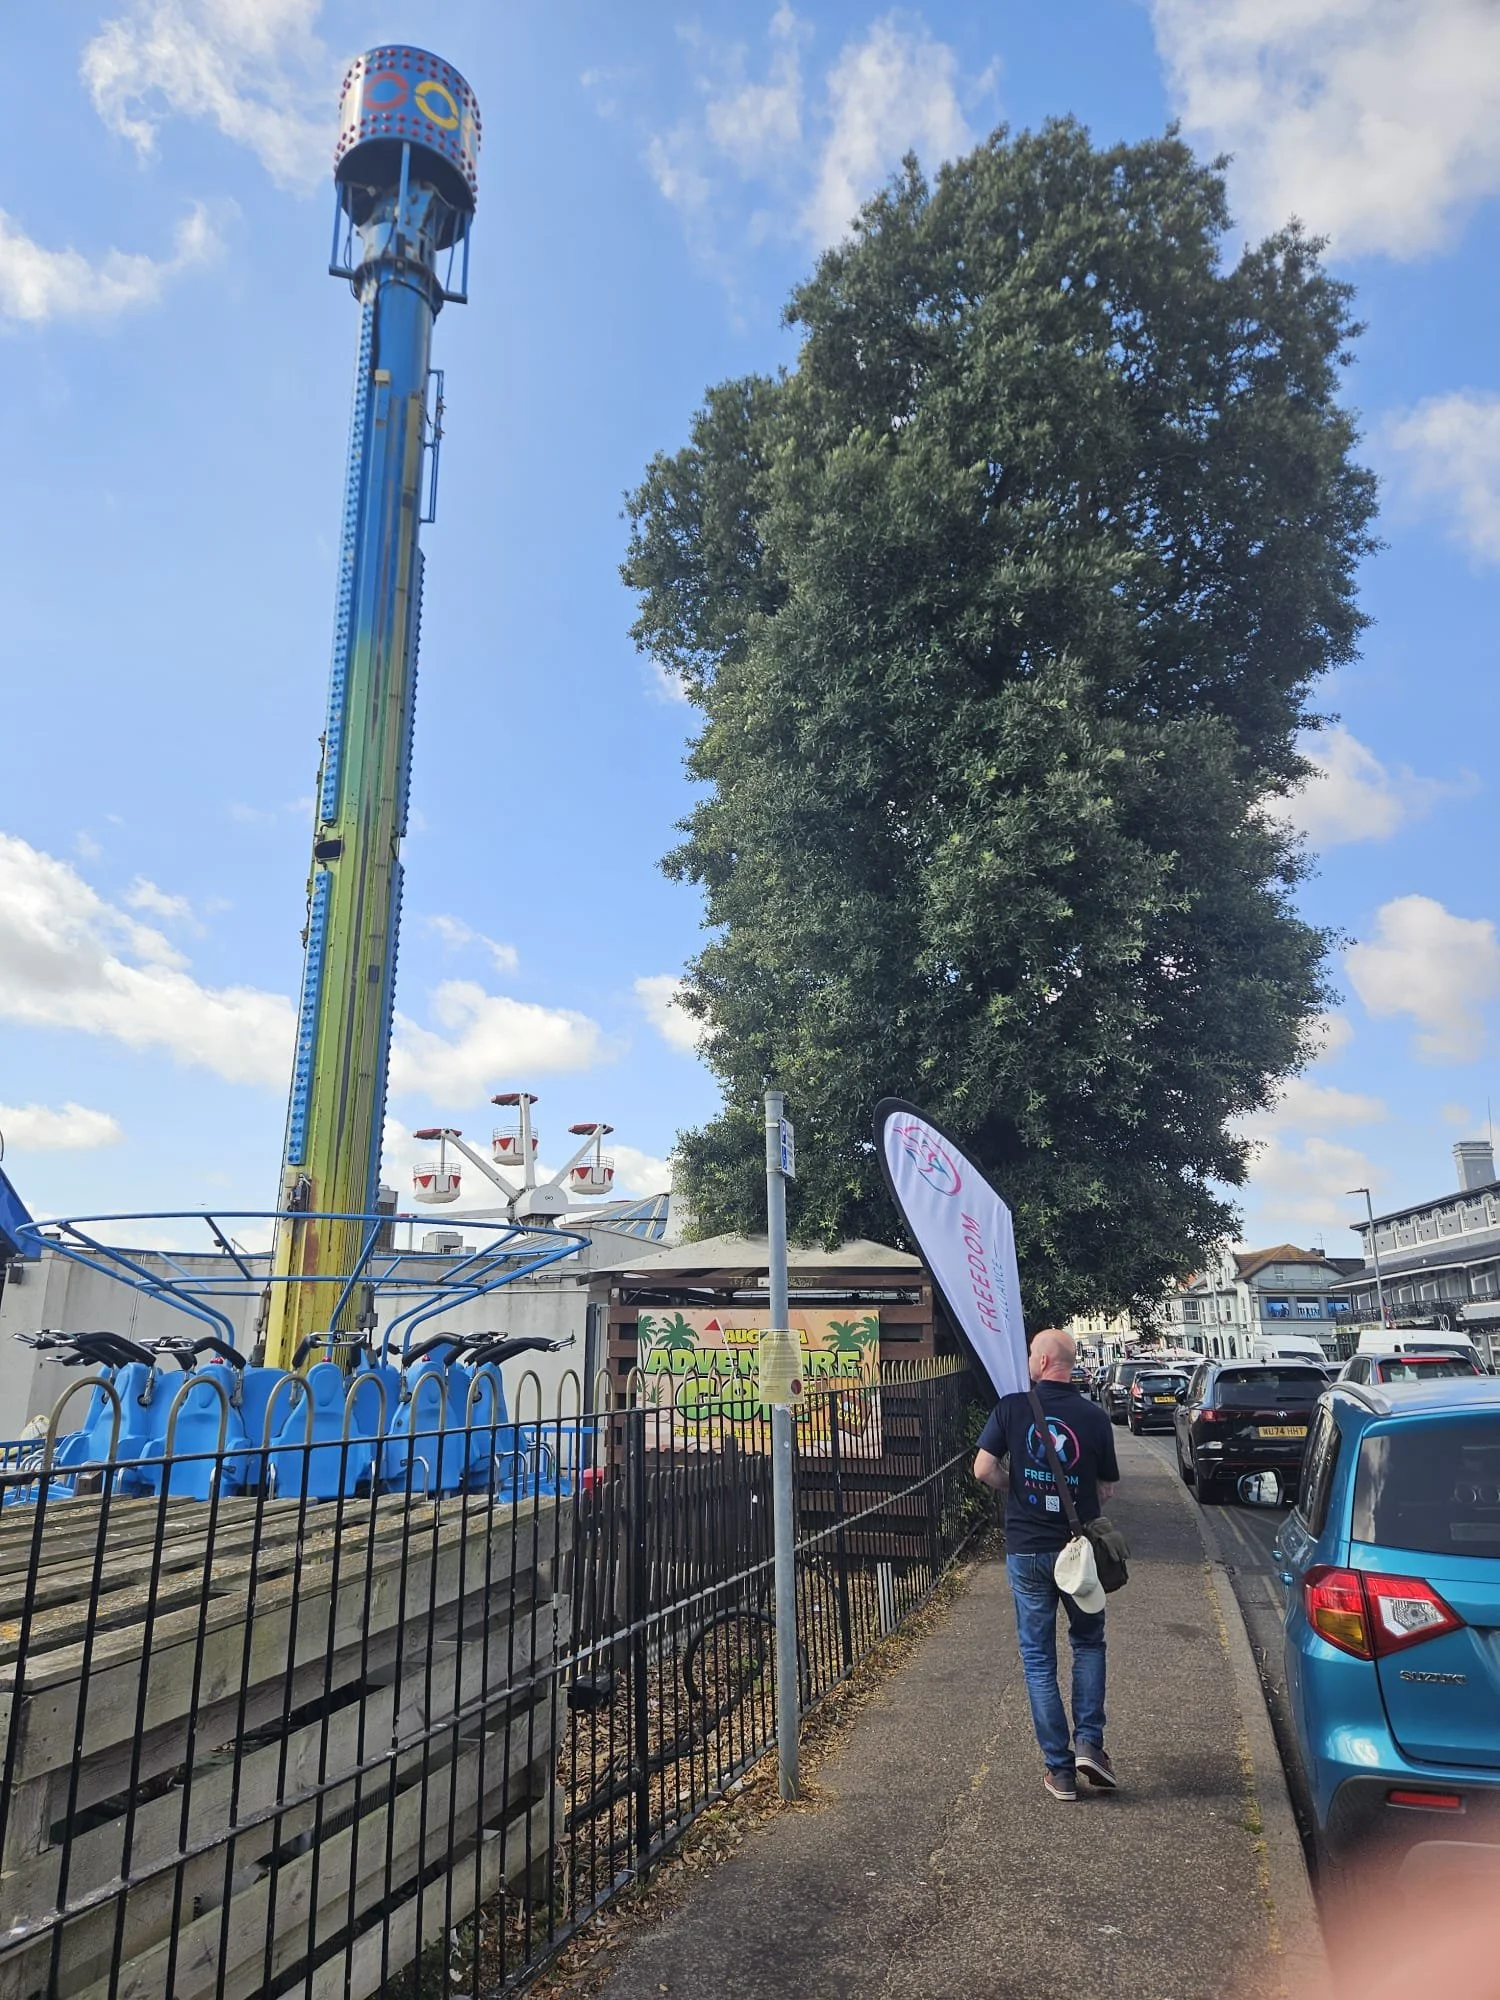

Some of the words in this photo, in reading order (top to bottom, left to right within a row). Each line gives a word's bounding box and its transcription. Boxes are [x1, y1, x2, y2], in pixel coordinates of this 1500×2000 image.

[960, 1212, 1002, 1333] FREEDOM
[991, 1256, 1011, 1322] ALLIANCE
[722, 1328, 808, 1344] AUGA
[644, 1348, 861, 1377] ADVENRE
[1399, 1669, 1467, 1685] SUZUKI
